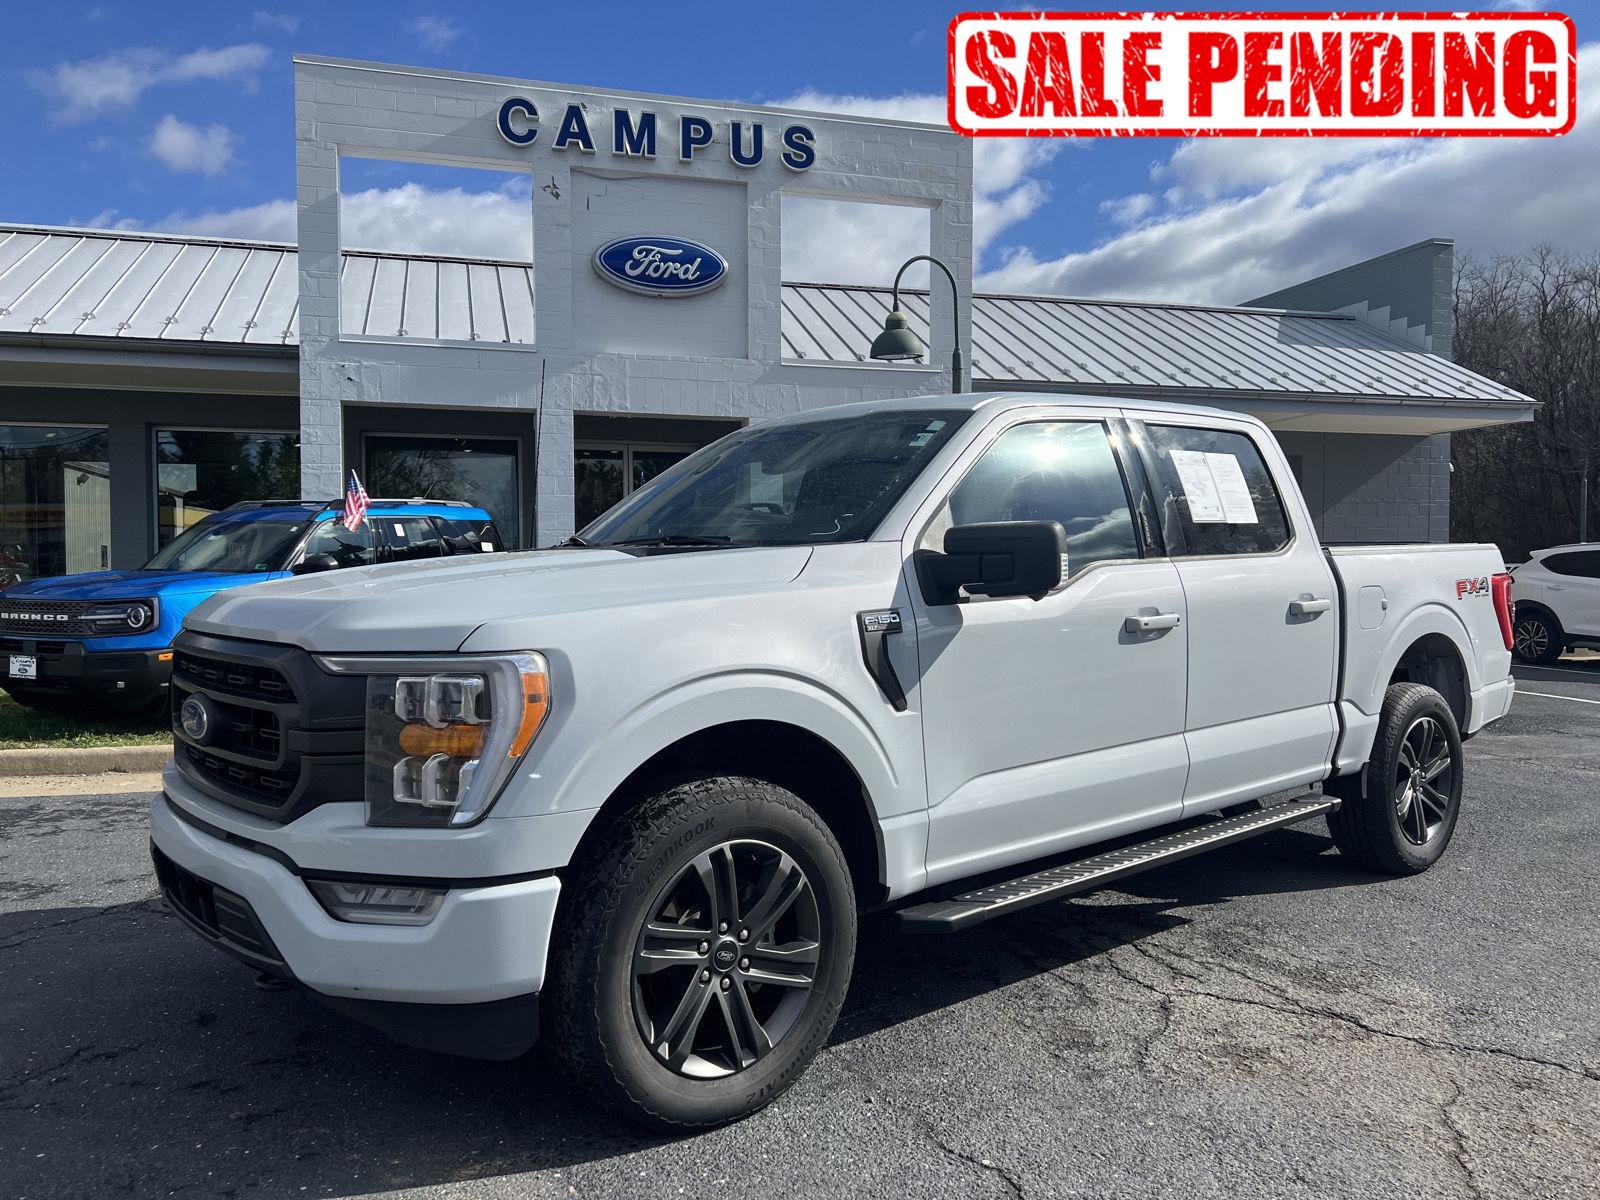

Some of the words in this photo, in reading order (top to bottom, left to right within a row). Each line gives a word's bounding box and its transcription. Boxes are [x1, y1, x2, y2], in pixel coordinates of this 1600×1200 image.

[496, 95, 817, 172] CAMPUS
[624, 245, 702, 281] Ford
[1456, 577, 1489, 600] FX4
[1, 612, 68, 620] BRONCO
